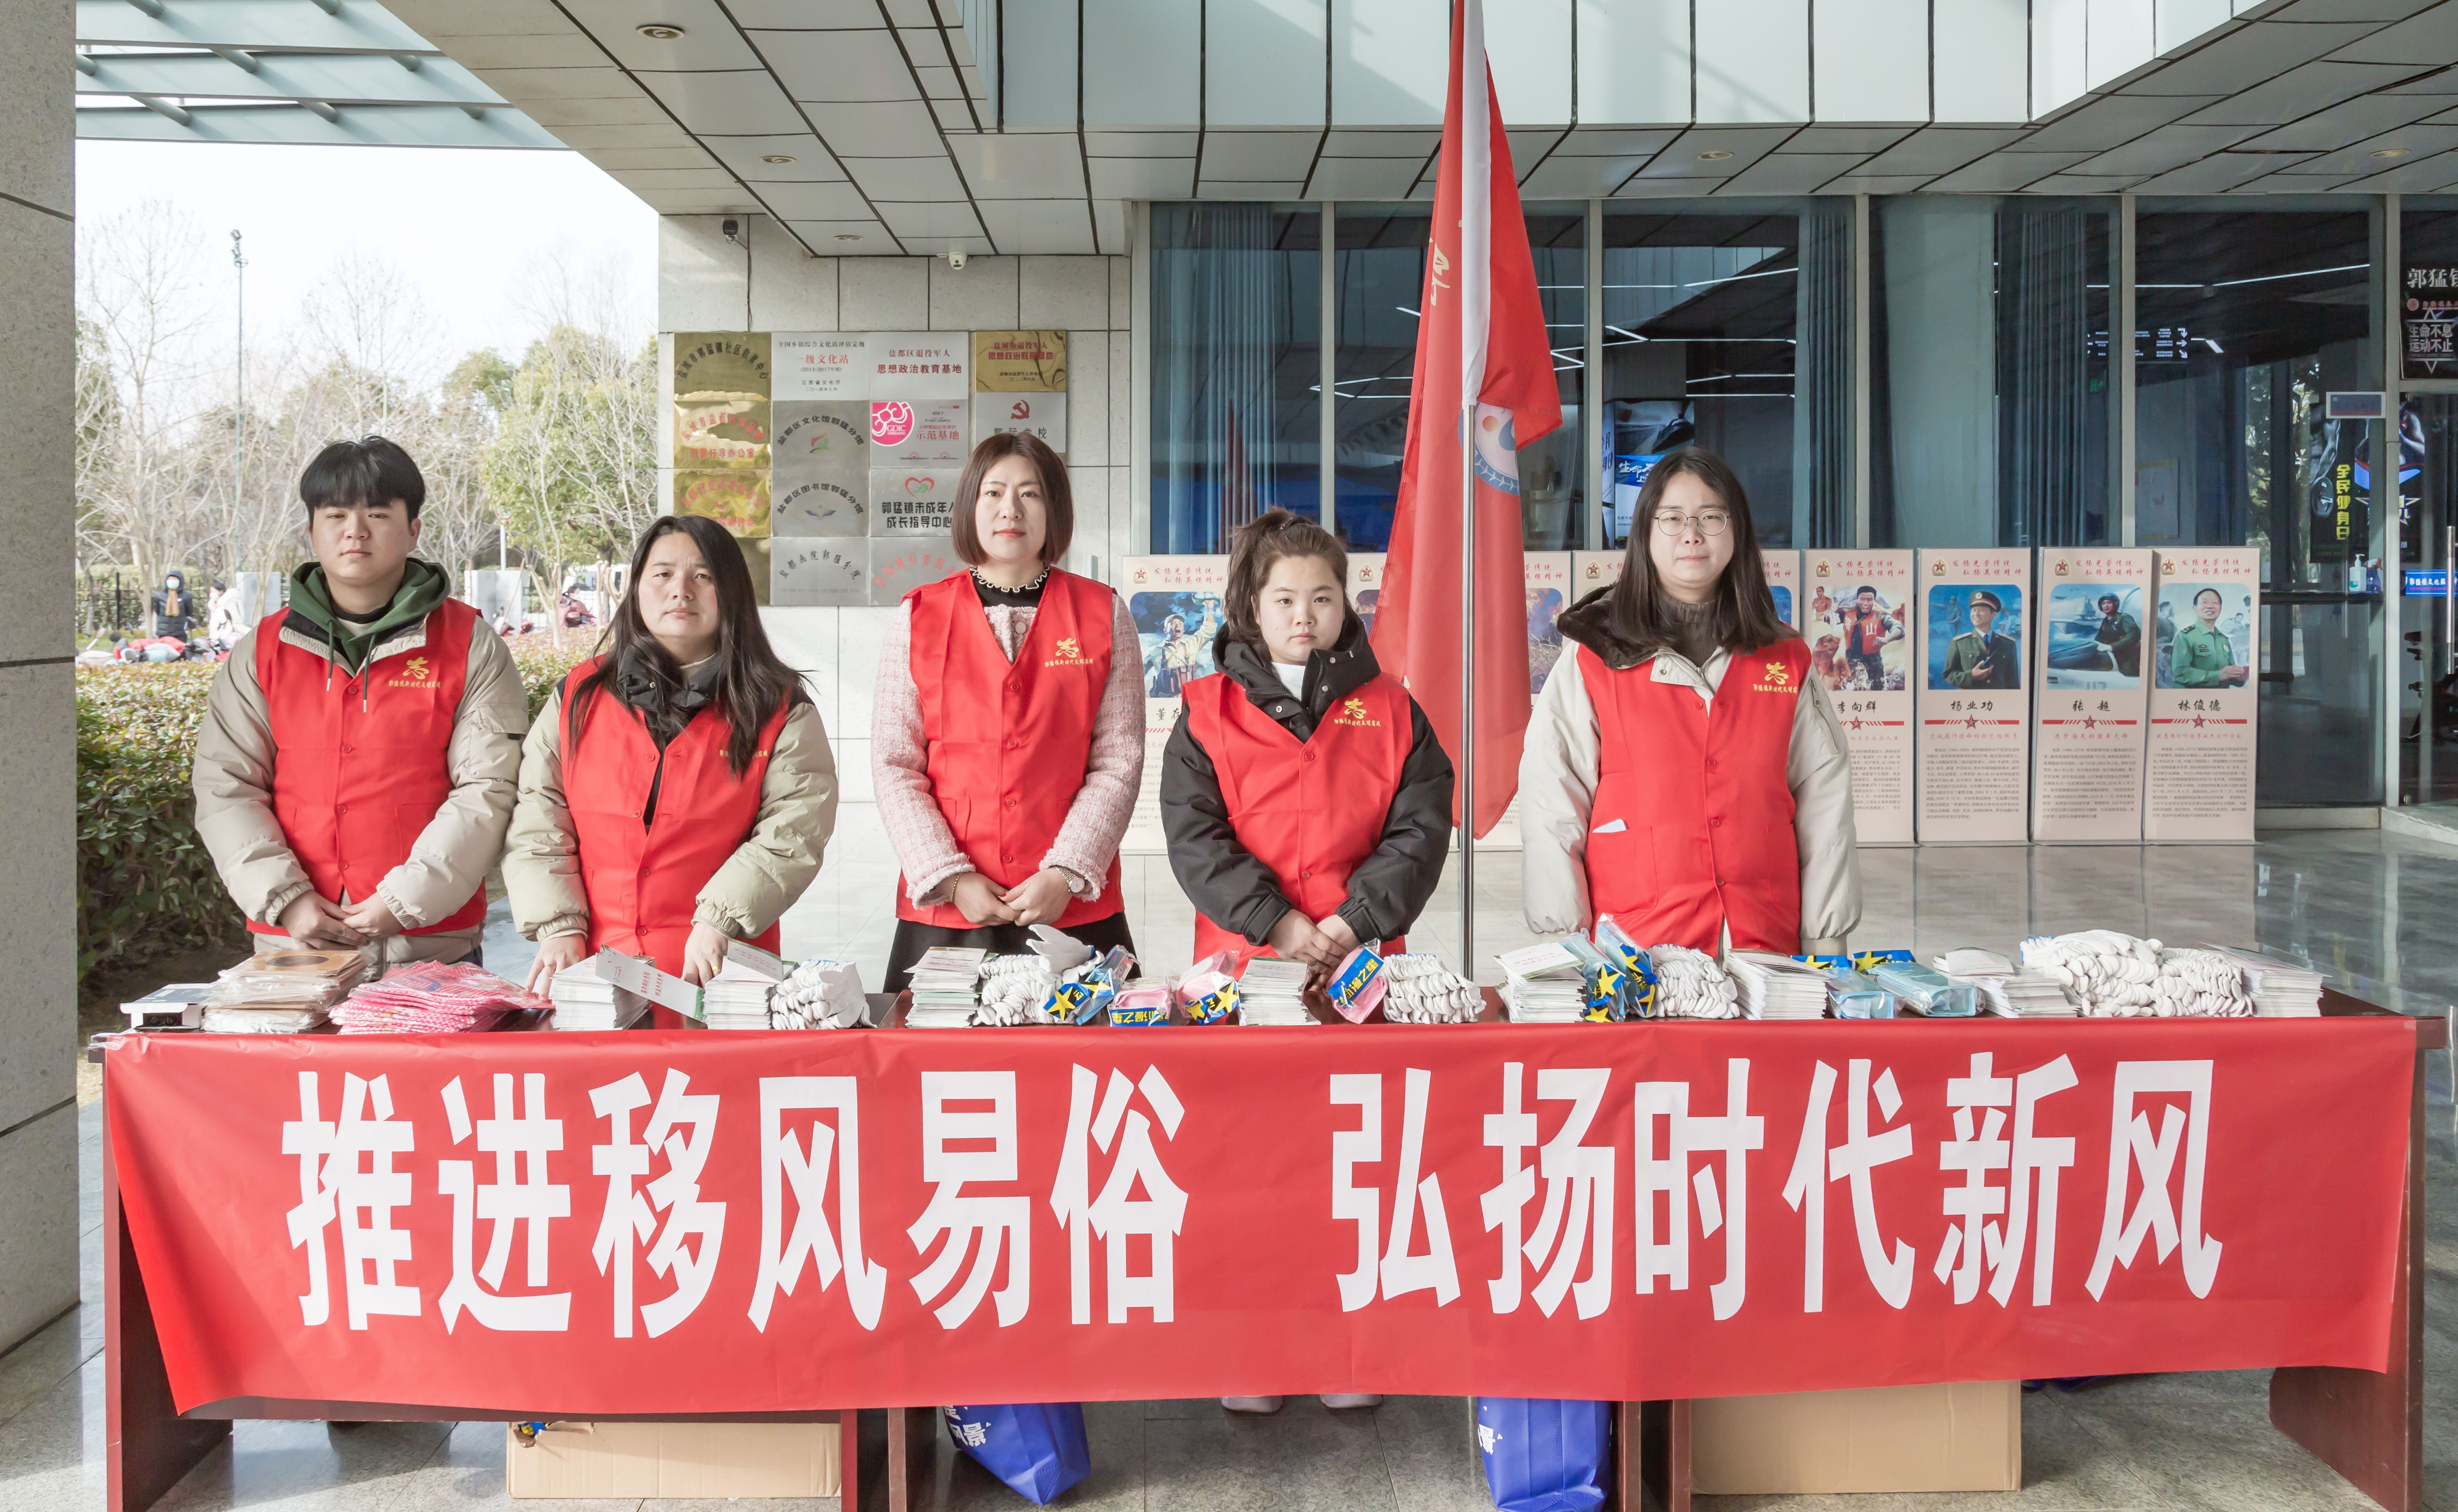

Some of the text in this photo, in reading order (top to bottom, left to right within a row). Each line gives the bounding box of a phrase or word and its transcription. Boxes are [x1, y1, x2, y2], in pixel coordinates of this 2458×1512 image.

[2409, 324, 2453, 338] 生命不息
[2409, 339, 2453, 352] 运动不止
[889, 349, 950, 358] 盐都区退役军人
[794, 355, 849, 364] 一级文化站
[877, 364, 962, 374] 思想政治教育基地
[778, 415, 864, 445] 盐都区文化馆郭猛分馆
[917, 430, 959, 440] 示范基地
[777, 483, 863, 514] 盐都区图书馆郭猛分馆
[2336, 464, 2351, 540] 全民健身日
[887, 516, 952, 528] 成长指导中心
[1836, 560, 1895, 568] 发扬光荣传统
[1953, 559, 2012, 568] 发扬光荣传统
[2075, 558, 2133, 567] 发扬光荣传统
[2182, 558, 2241, 567] 发扬光荣传统
[1846, 569, 1905, 577] 弘扬英模精神
[1963, 569, 2022, 577] 弘扬英模精神
[2085, 568, 2144, 577] 弘扬英模精神
[2192, 567, 2251, 576] 弘扬英模精神
[1837, 700, 1877, 714] 李向群
[1950, 700, 1993, 712] 杨业功
[2178, 699, 2222, 711] 林俊德
[282, 1052, 2222, 1338] 推进移风易俗 弘扬时代新风
[1478, 1424, 1496, 1455] 景
